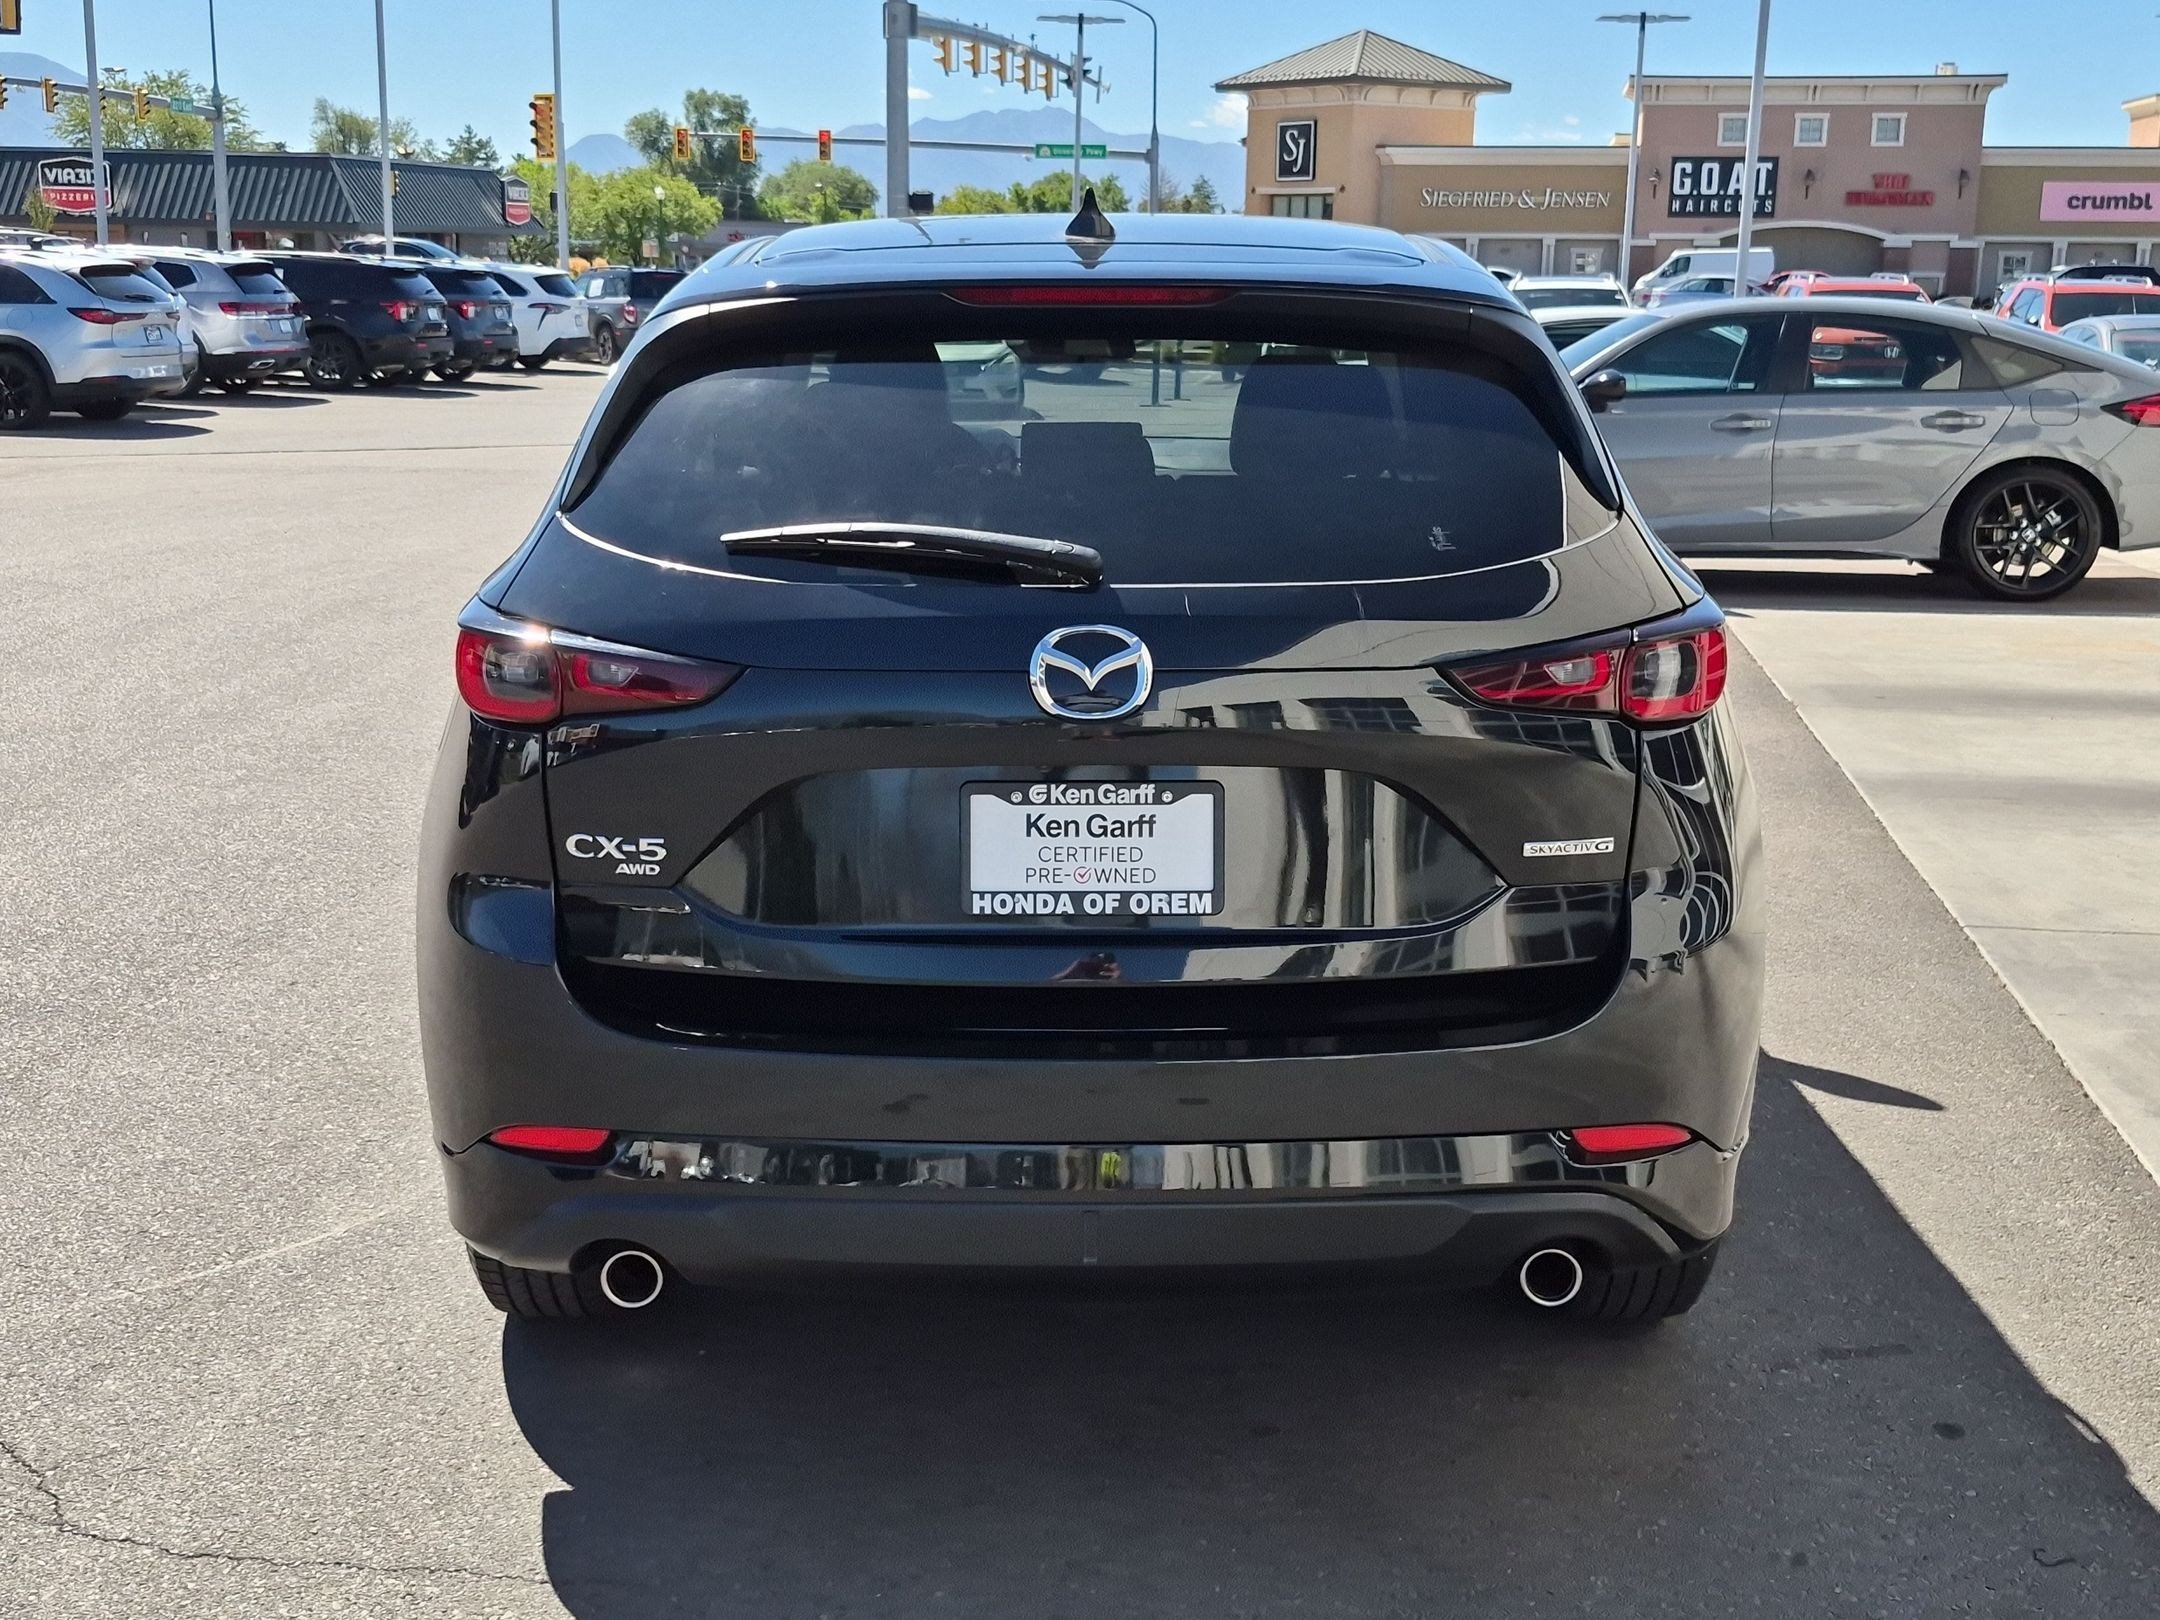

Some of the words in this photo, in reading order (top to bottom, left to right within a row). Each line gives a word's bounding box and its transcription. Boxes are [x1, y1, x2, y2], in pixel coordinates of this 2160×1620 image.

[43, 167, 96, 185] VIA31
[1672, 162, 1774, 196] G.O.AT.
[49, 192, 96, 202] PIZZERI
[1420, 187, 1514, 208] SIEGFRIED
[1517, 188, 1537, 209] &
[1540, 187, 1610, 211] JENSEN
[2067, 192, 2154, 211] crumbl
[1050, 784, 1095, 805] Ken
[1097, 783, 1156, 805] Garff
[1026, 813, 1080, 838] Ken
[1086, 813, 1157, 839] Garff
[565, 833, 668, 862] CX-5
[1037, 846, 1144, 863] CERTIFIED
[615, 862, 661, 876] AWD
[971, 892, 1076, 915] HONDA
[1082, 892, 1122, 915] OF
[1129, 892, 1213, 915] OREM
